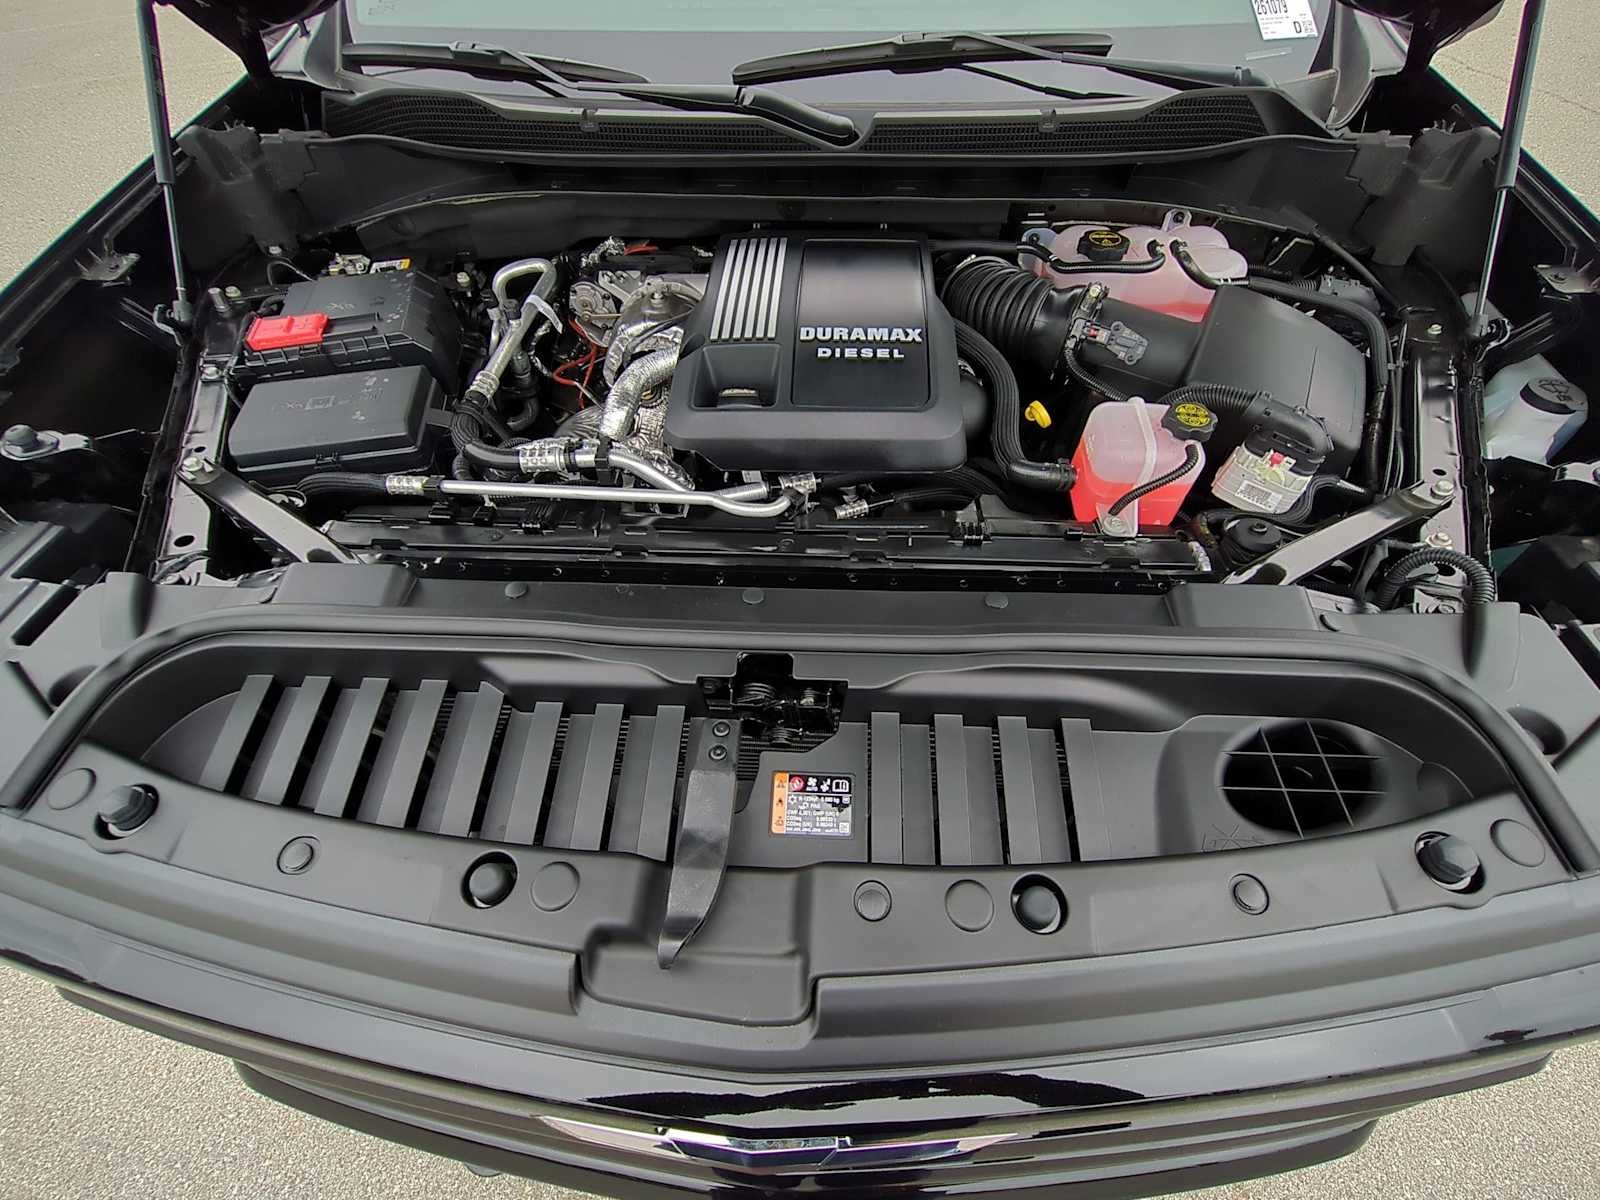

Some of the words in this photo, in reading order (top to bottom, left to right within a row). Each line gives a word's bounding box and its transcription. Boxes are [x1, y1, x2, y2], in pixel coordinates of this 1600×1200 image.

[1254, 0, 1288, 15] 261079
[799, 326, 923, 343] DURAMAX
[816, 346, 905, 359] DIESEL
